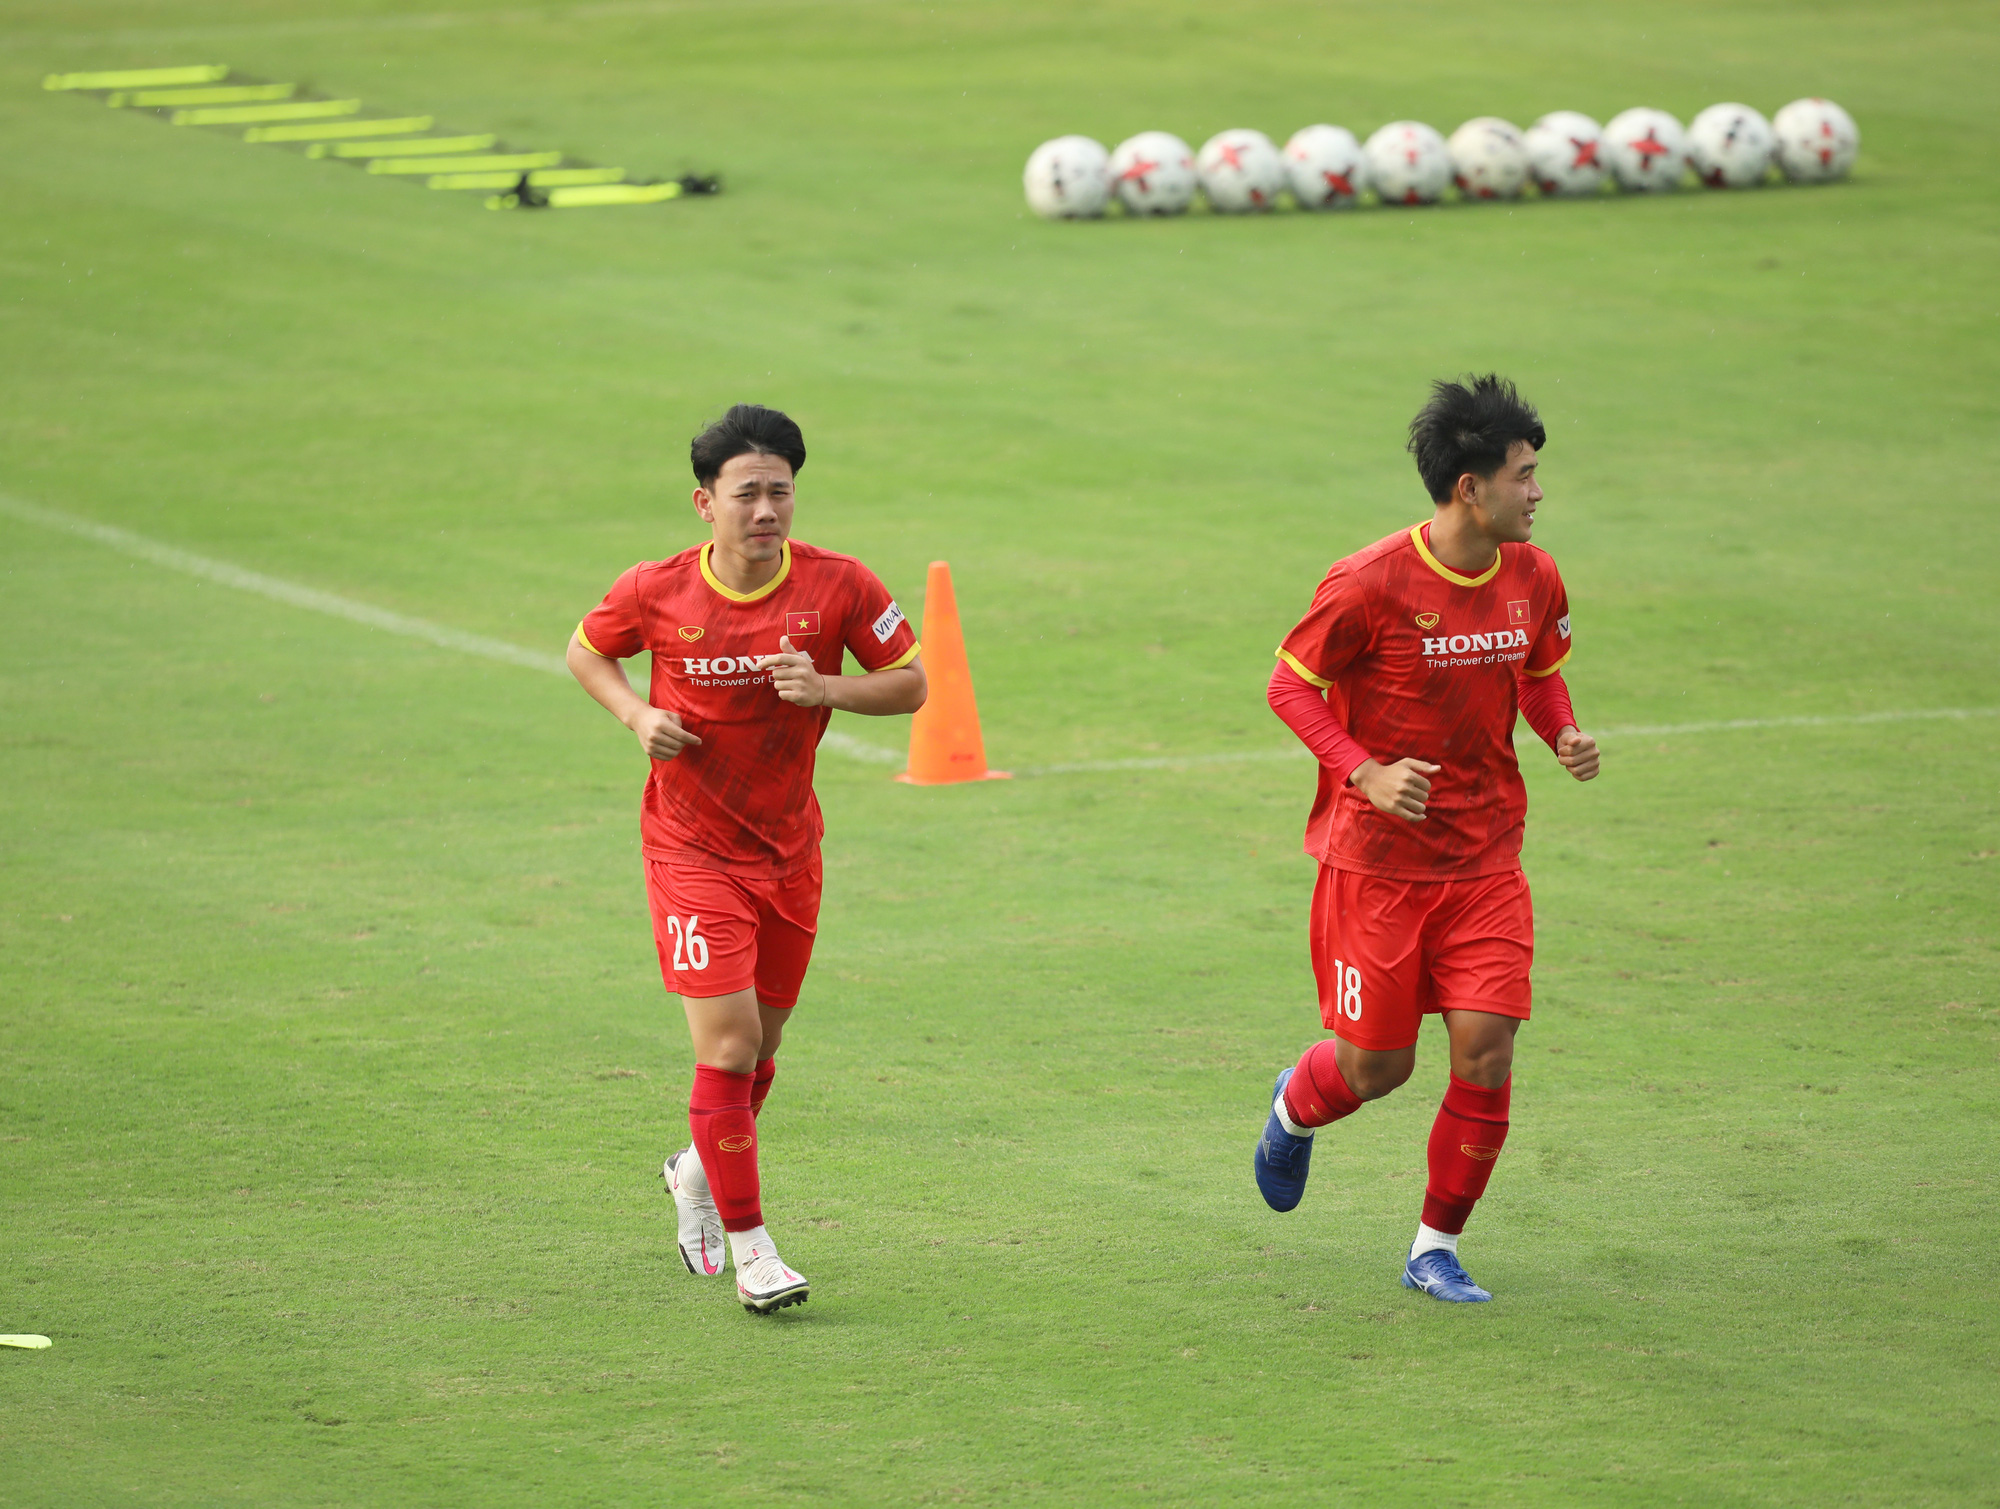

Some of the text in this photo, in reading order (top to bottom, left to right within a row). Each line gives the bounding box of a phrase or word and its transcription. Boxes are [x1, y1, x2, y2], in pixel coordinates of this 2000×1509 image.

[1421, 628, 1530, 656] HONDA
[682, 650, 815, 676] HON
[1426, 651, 1526, 669] The Power of Dreams
[688, 677, 711, 688] The
[712, 677, 750, 688] Power
[752, 675, 766, 685] of
[666, 915, 710, 971] 26
[1333, 958, 1363, 1022] 18
